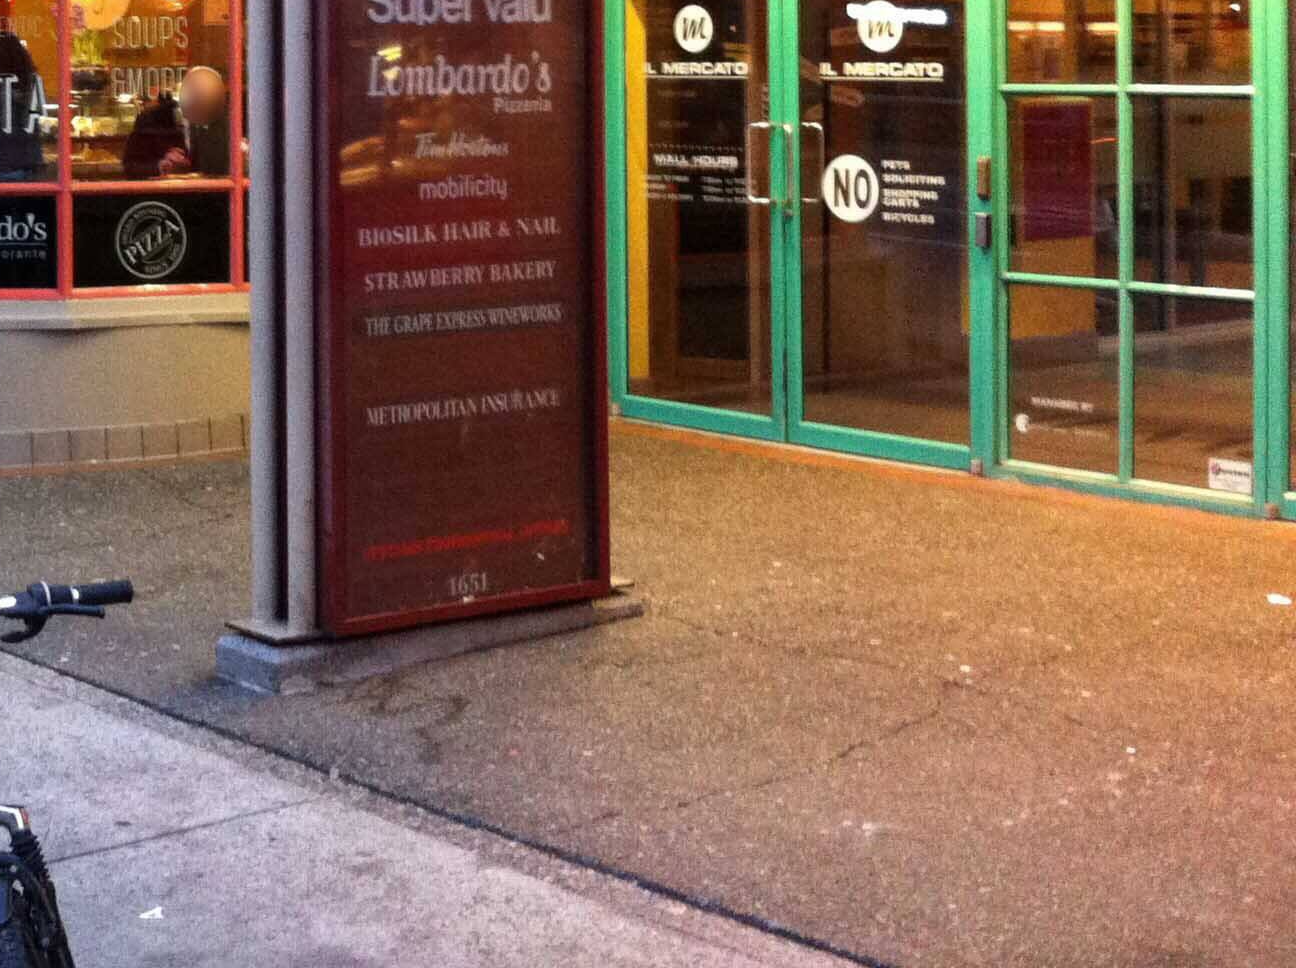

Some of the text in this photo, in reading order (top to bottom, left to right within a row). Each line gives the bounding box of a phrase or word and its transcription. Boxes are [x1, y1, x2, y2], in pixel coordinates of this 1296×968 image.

[114, 16, 189, 49] SOUPS
[367, 50, 553, 98] Lombardo's
[661, 62, 749, 76] MERCATO
[819, 62, 945, 77] IL MERCATO
[418, 174, 509, 201] mobilicity
[833, 168, 872, 209] NO
[123, 218, 180, 265] PIZZA
[357, 224, 439, 248] BIOSILK
[442, 221, 493, 242] HAIR
[363, 260, 558, 293] STRAWBERRY BAKERY
[365, 316, 392, 337] THE
[365, 388, 561, 425] METROPOLITAN INSURANCE
